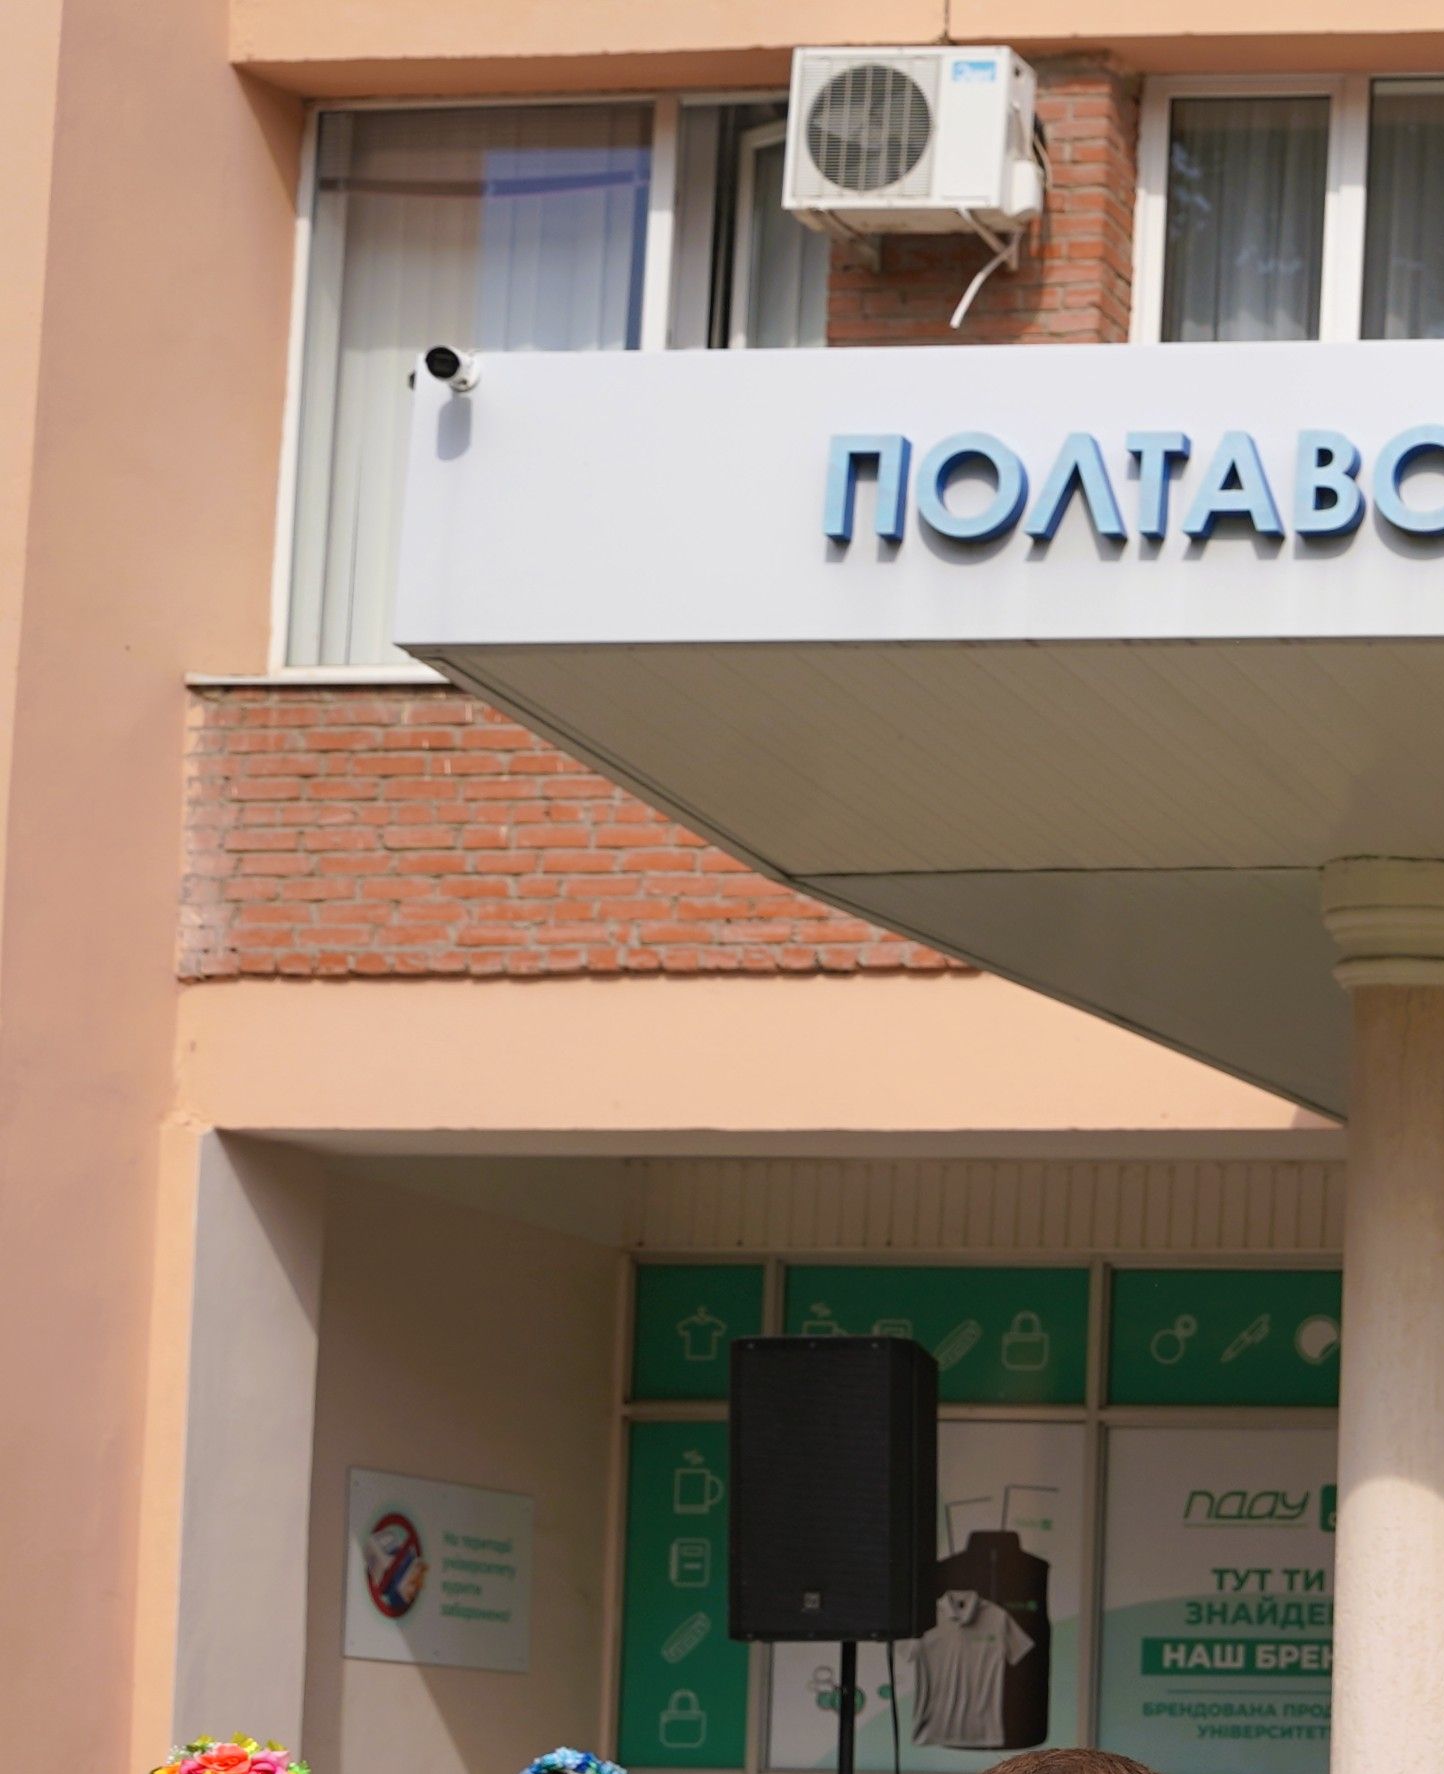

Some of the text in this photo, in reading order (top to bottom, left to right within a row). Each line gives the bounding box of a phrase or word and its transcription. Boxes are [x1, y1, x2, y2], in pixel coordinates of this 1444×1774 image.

[1212, 1568, 1325, 1592] ТУТ ТИ
[1185, 1596, 1334, 1629] ЗНАЙДЕ
[1162, 1643, 1334, 1669] НАШ БРЕН
[1143, 1702, 1277, 1718] БРЕНДОВАНА
